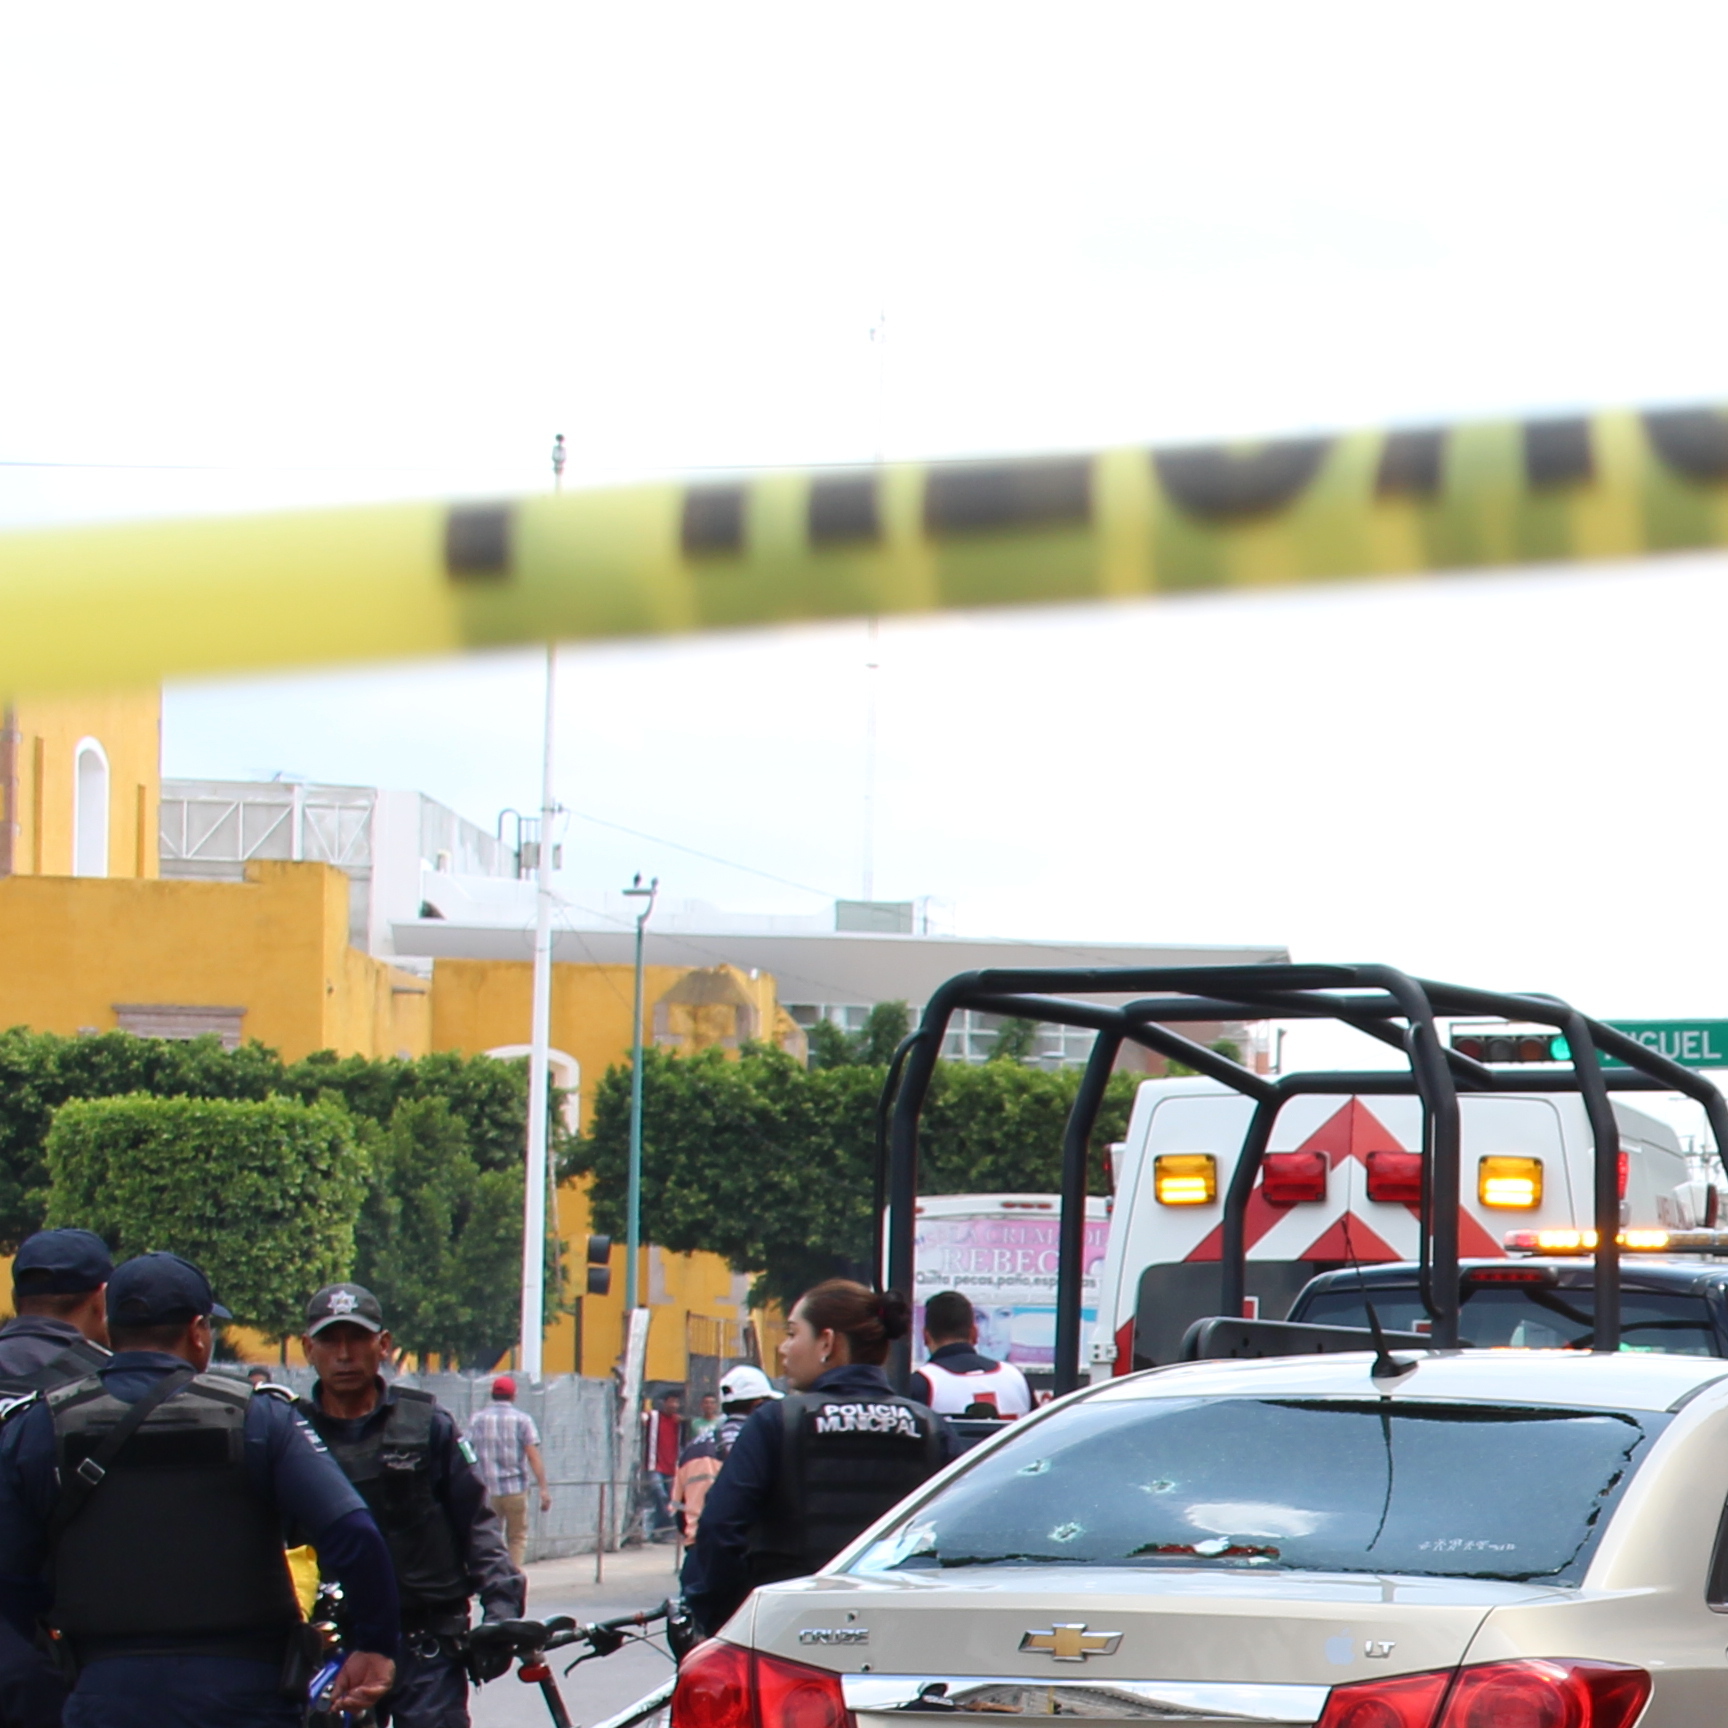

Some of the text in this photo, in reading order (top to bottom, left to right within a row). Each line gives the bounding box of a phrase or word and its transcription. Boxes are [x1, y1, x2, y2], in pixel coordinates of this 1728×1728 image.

[823, 1403, 914, 1420] POLICIA
[799, 1627, 869, 1645] CRUZE
[1365, 1640, 1396, 1659] LT
